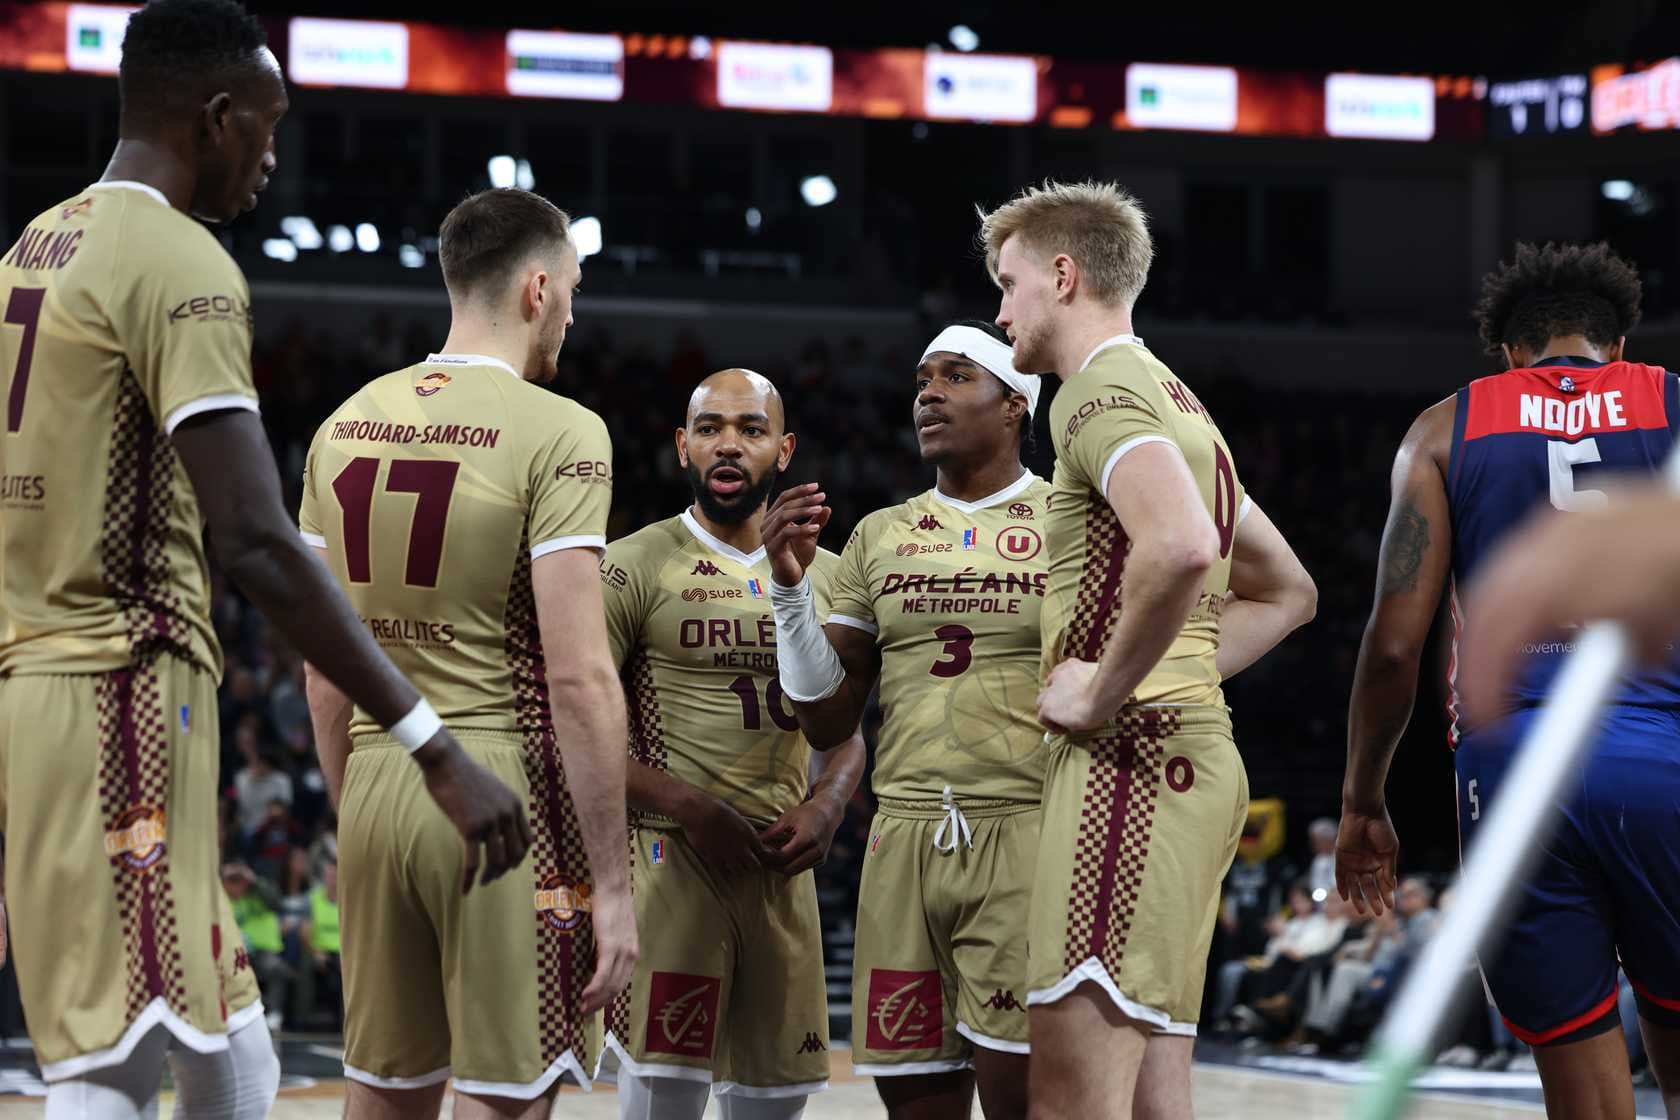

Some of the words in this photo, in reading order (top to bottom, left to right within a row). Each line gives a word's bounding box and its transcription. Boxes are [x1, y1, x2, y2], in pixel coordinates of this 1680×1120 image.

[6, 226, 84, 270] NIANG
[4, 286, 47, 432] 7
[1519, 390, 1627, 436] NDOYE
[330, 420, 500, 448] THIROUARD-SAMSON
[0, 474, 46, 501] LITES
[331, 456, 461, 588] 17
[919, 542, 953, 554] suez
[709, 588, 744, 600] suez
[881, 567, 1050, 596] ORLÉANS
[902, 595, 1022, 614] MÉTROPOLE
[680, 614, 778, 649] ORLÉ
[713, 649, 780, 668] MÉTRO
[929, 624, 976, 678] 3
[1165, 755, 1195, 793] 0
